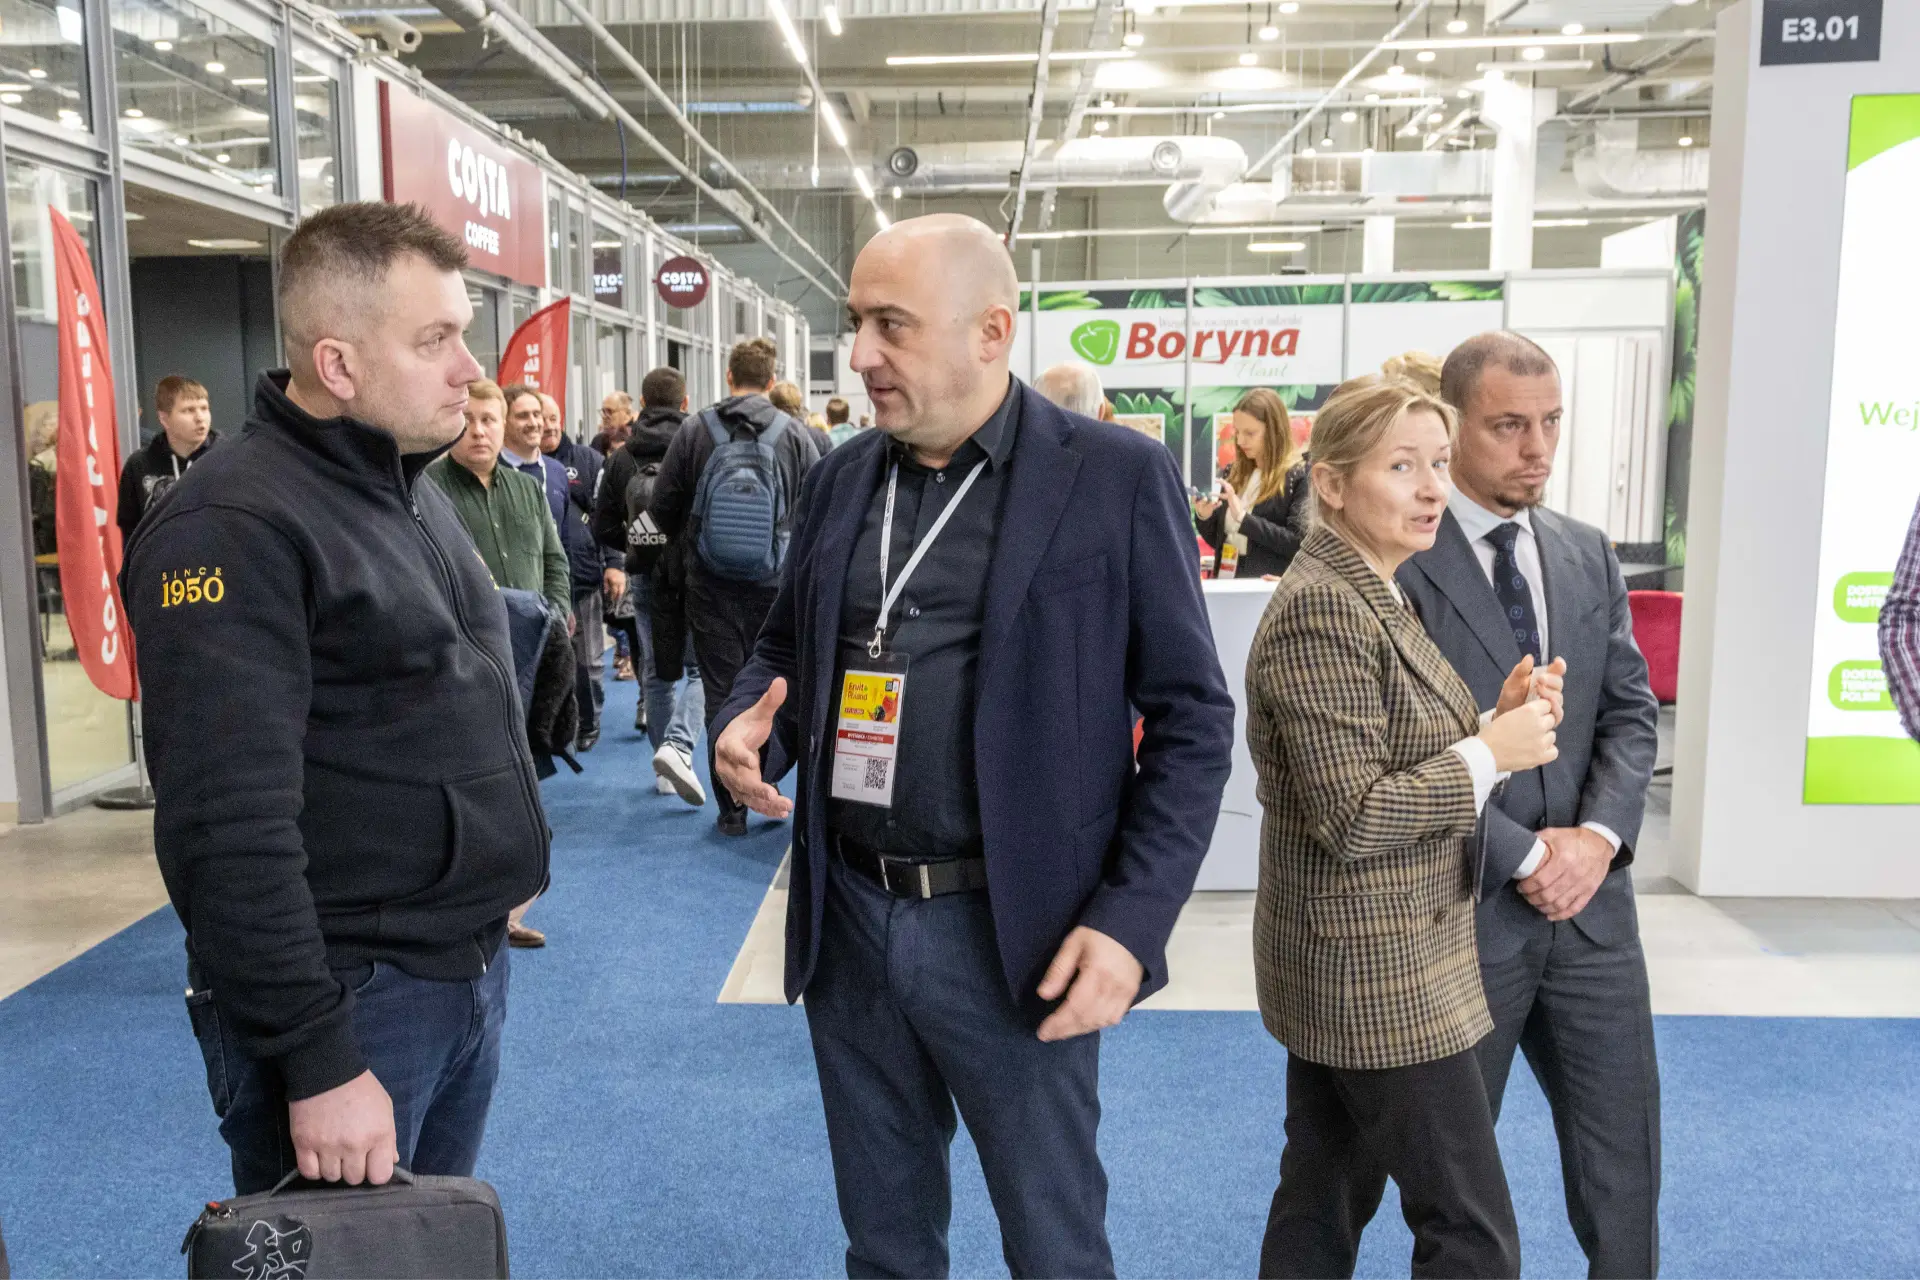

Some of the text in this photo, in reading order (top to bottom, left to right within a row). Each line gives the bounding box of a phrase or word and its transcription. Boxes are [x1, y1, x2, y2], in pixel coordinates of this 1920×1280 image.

[1782, 15, 1859, 42] E3.01
[448, 138, 510, 220] COSTA
[465, 220, 499, 256] COFFEE
[661, 272, 703, 285] COSTA
[1125, 322, 1300, 364] Boryna
[162, 566, 223, 581] SINCE
[162, 576, 225, 608] 1950
